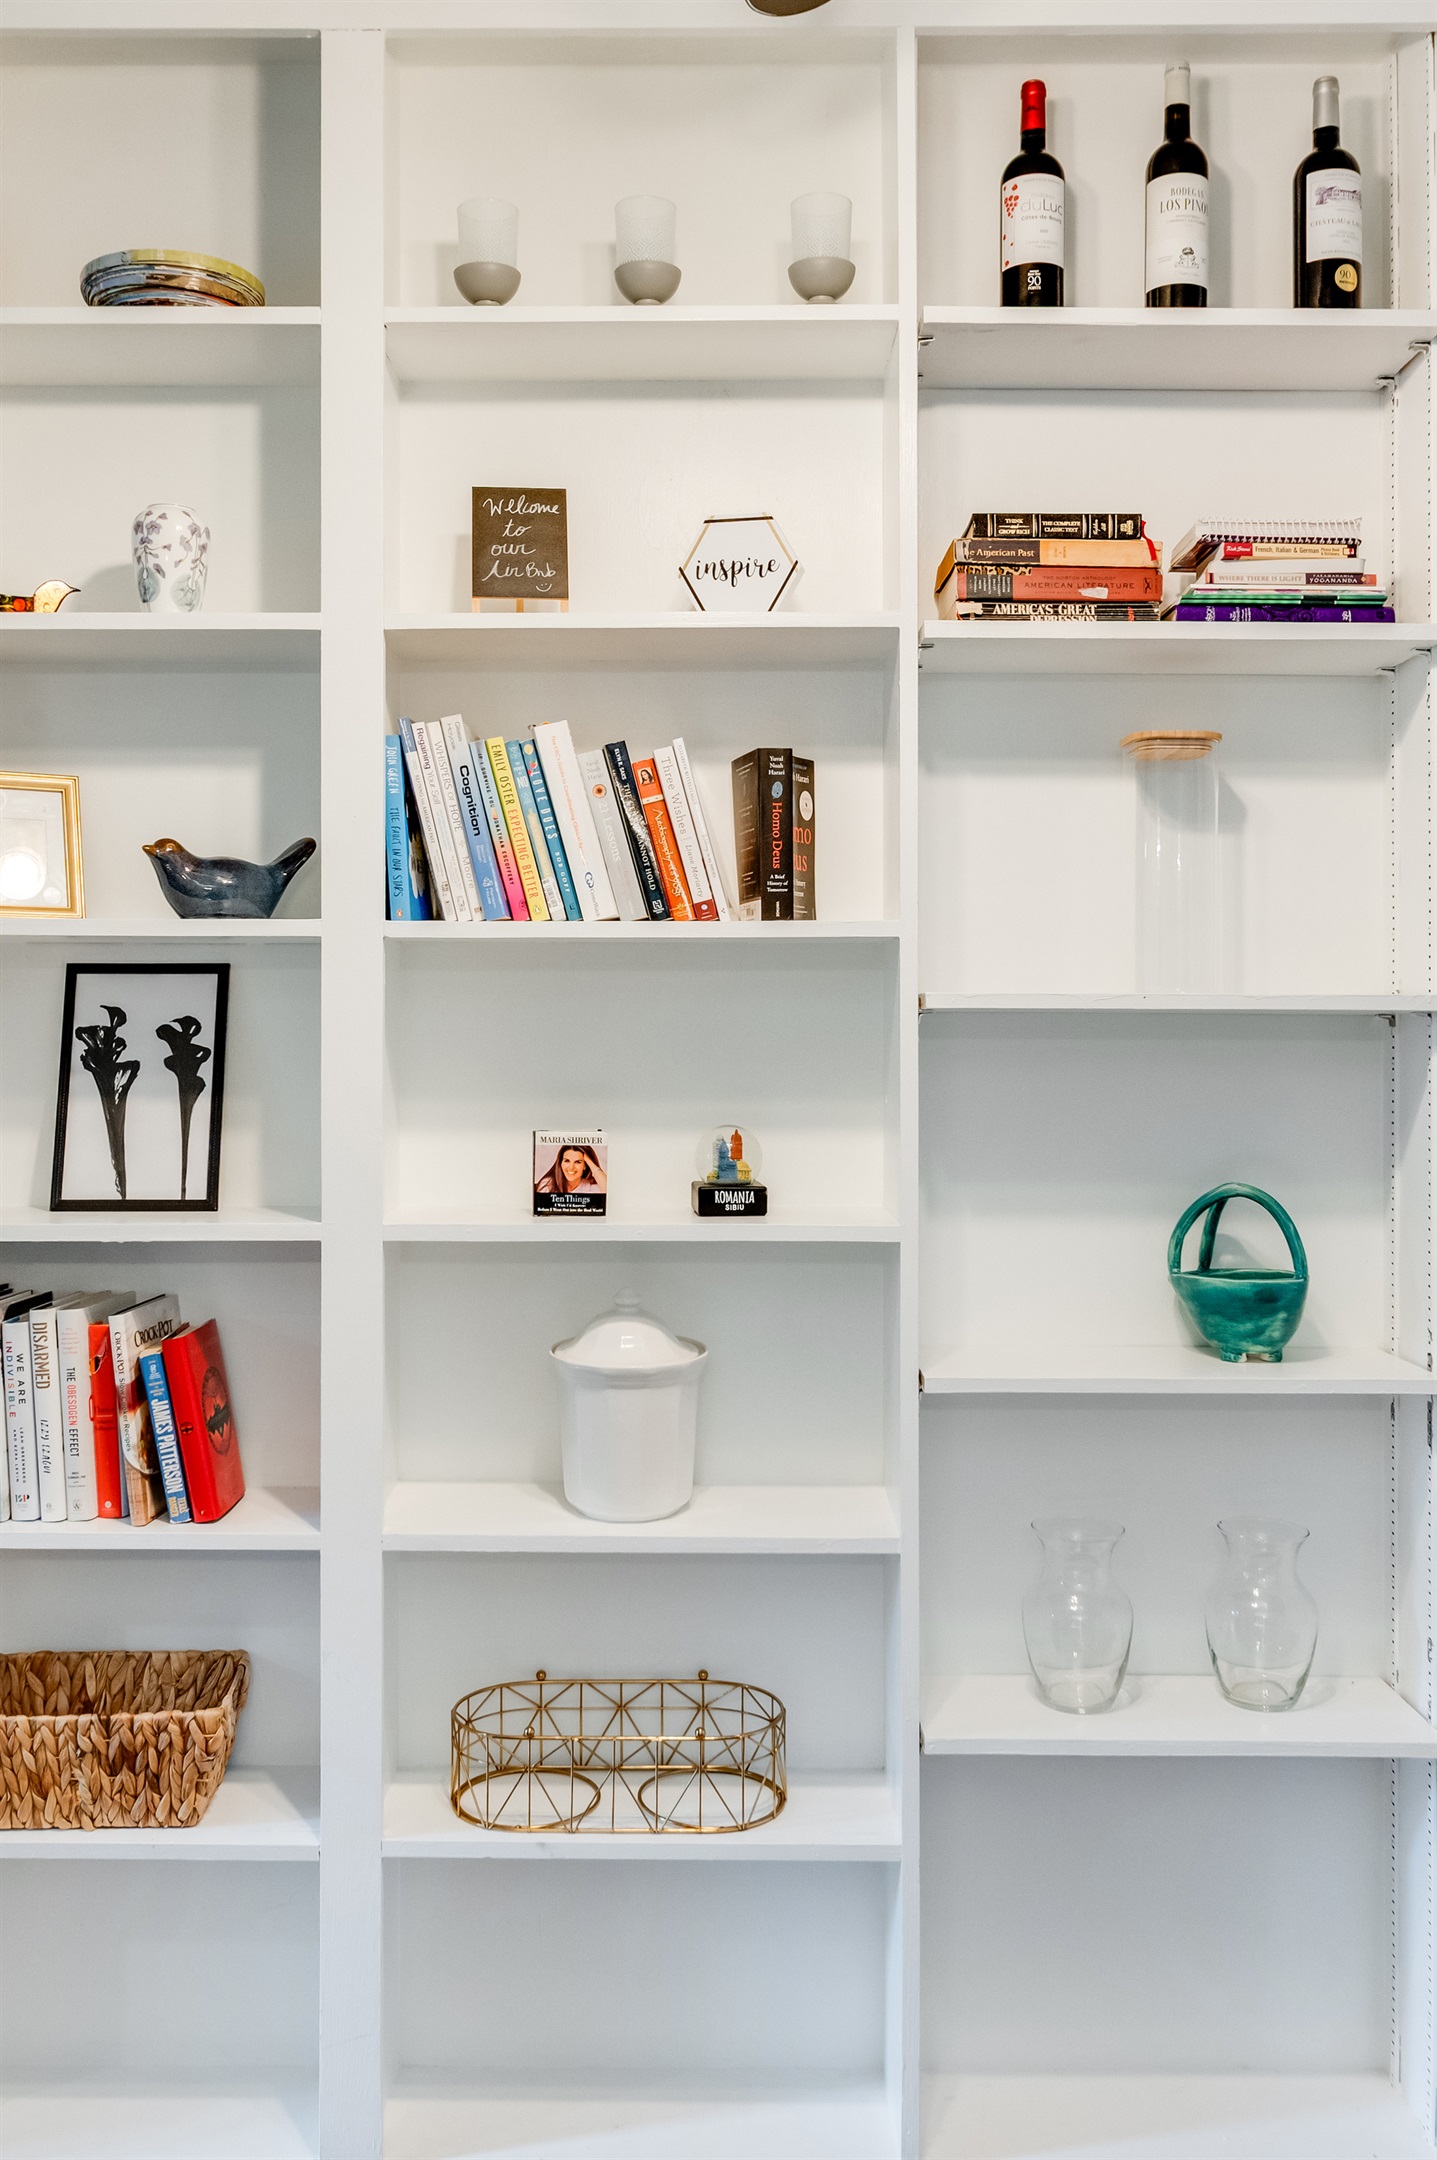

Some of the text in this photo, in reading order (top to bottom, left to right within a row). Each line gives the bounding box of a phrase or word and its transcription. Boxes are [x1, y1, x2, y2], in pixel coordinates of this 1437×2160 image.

[1160, 199, 1181, 214] LOS
[1170, 187, 1204, 198] BODEGAS
[1027, 275, 1042, 286] 90
[1339, 269, 1351, 279] 90
[482, 494, 561, 517] Welcome
[501, 518, 532, 537] to
[490, 541, 537, 556] our
[976, 549, 1015, 558] American
[1018, 549, 1035, 557] Past
[695, 555, 781, 588] inspire
[993, 604, 1097, 615] AMERICA'S GREAT
[416, 727, 431, 770] Regaining
[386, 745, 400, 794] JOHN GREEN
[460, 765, 480, 836] Cognition
[661, 756, 675, 790] Three
[671, 792, 687, 835] Wishes
[434, 741, 453, 790] WHISPERS
[449, 804, 462, 832] HOPE
[462, 856, 475, 889] Moore
[481, 767, 491, 793] SURVIVE
[502, 850, 515, 885] ESCOFFERY
[491, 744, 539, 898] EMILY OSTER EXPECTING BETTER
[530, 770, 547, 802] LOVE
[540, 807, 558, 840] DOES
[554, 851, 564, 868] BOB
[560, 871, 570, 893] GOFF
[390, 807, 404, 897] THE FAULT IN OUR STARS
[602, 816, 620, 862] Lessons
[653, 809, 673, 863] Autobiography
[772, 802, 783, 869] Homo Deus
[793, 826, 812, 845] mo
[793, 853, 808, 871] us
[645, 868, 656, 891] HOLD
[550, 1194, 591, 1205] Ten Things
[714, 1190, 755, 1204] ROMANIA
[724, 1203, 745, 1211] SIBIU
[32, 1322, 50, 1389] DISARMED
[5, 1341, 17, 1418] INDIVISIBLE
[16, 1353, 27, 1405] WE ARE
[66, 1367, 76, 1382] THE
[66, 1384, 79, 1426] OBESOGEN
[150, 1397, 173, 1435] JAMES
[68, 1428, 80, 1458] EFFECT
[123, 1421, 131, 1452] Recipes
[156, 1433, 183, 1494] PATTERSON
